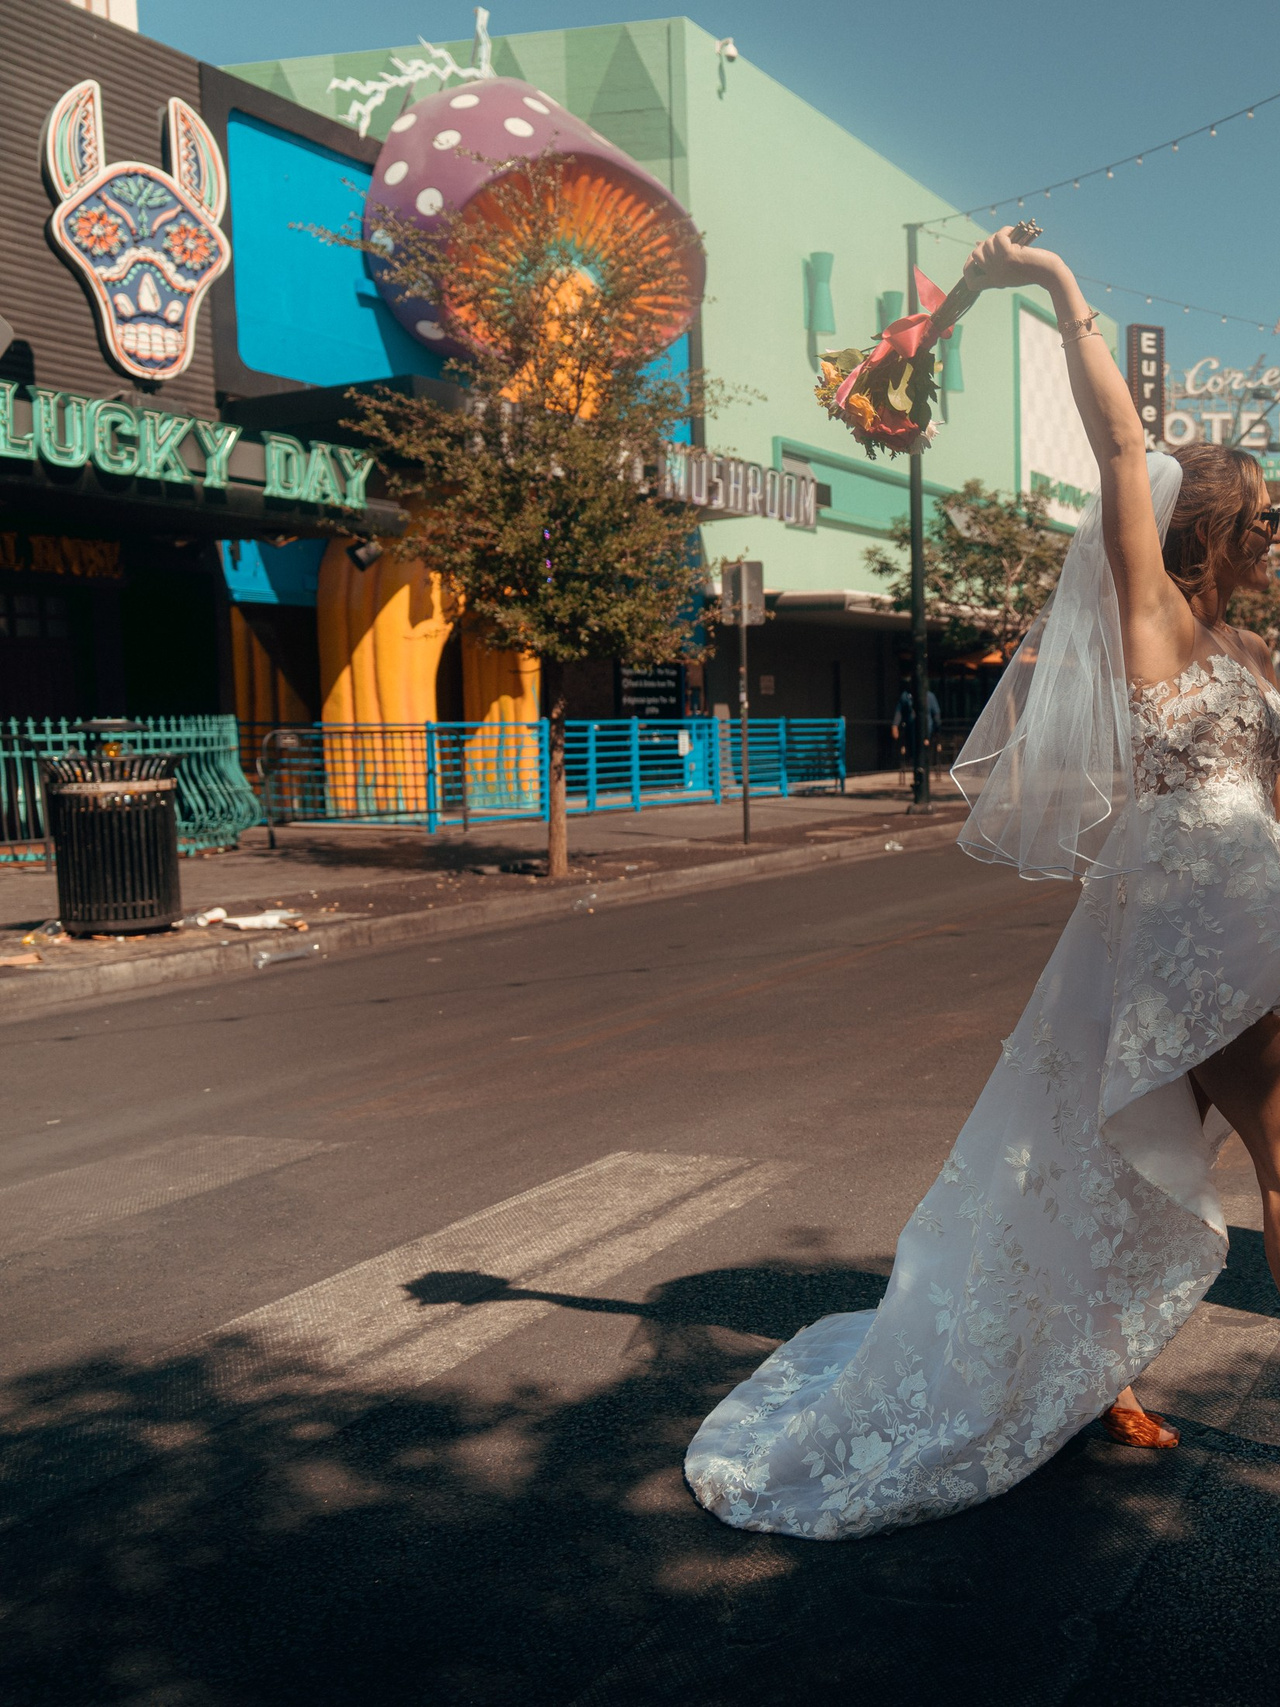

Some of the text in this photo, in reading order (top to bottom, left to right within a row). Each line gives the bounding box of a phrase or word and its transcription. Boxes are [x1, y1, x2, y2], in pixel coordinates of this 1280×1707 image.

[0, 379, 243, 488] LUCKY
[260, 430, 374, 509] DAY
[1140, 332, 1158, 451] Eurek
[660, 443, 817, 527] MUSHROOM
